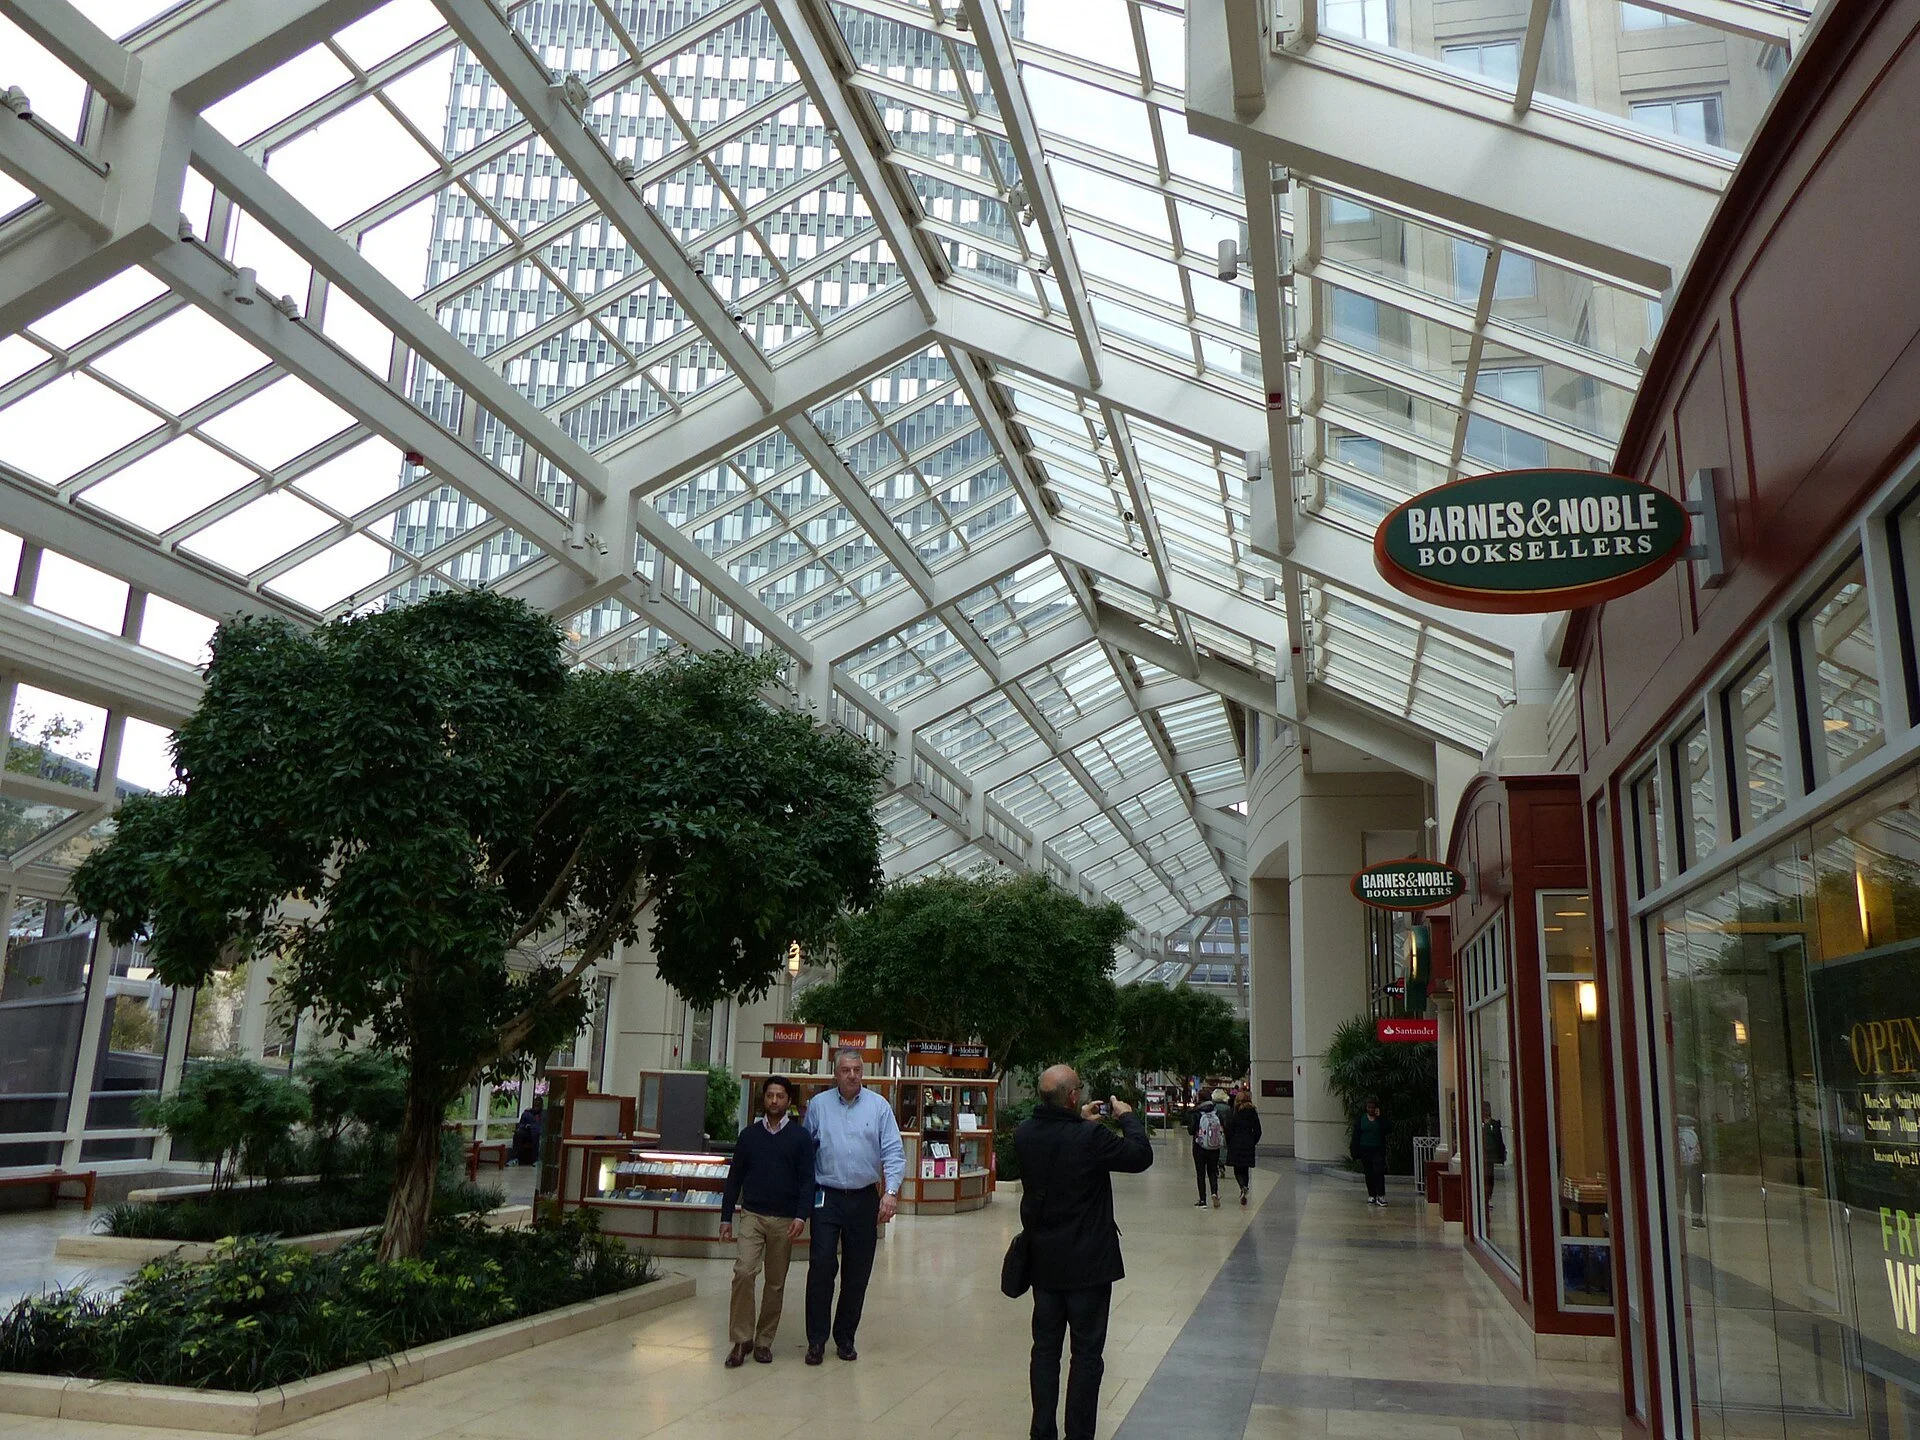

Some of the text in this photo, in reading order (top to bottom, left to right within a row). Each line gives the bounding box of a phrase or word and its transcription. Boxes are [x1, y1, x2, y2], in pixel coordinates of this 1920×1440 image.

[1418, 535, 1653, 567] BOOKSELLERS
[1366, 887, 1452, 898] BOOKSELLERS
[774, 1031, 804, 1040] iModify
[1395, 1026, 1434, 1035] Santander
[839, 1039, 865, 1047] iModify
[1851, 1016, 1920, 1076] OPEN
[1863, 1093, 1891, 1109] Mon-Sat
[1866, 1114, 1892, 1137] Sunday
[1893, 1150, 1911, 1168] Open
